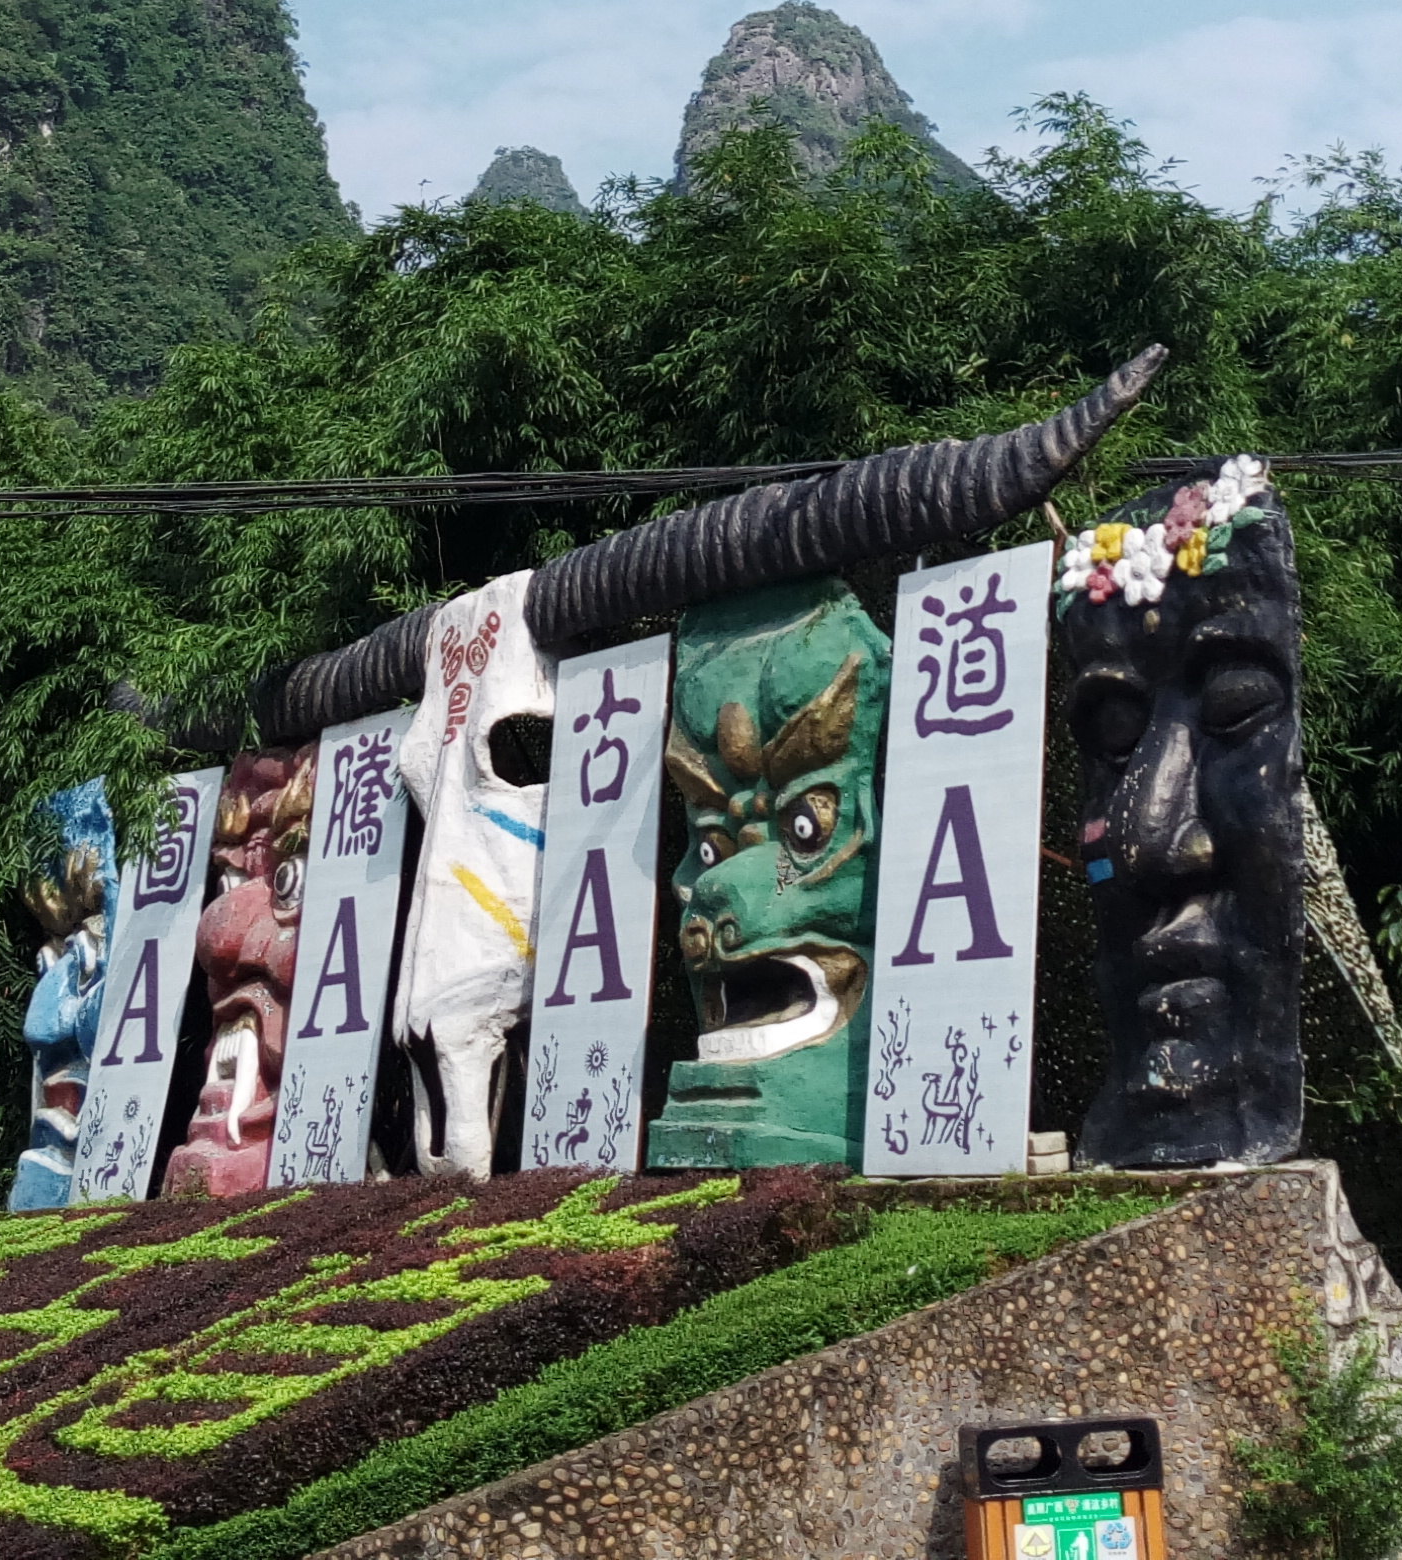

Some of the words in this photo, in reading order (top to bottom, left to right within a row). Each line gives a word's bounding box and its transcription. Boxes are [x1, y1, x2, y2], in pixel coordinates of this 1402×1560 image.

[915, 572, 1017, 739] 道
[573, 668, 642, 807] 古
[544, 847, 632, 1008] A
[891, 785, 1013, 966] A
[100, 938, 164, 1067] A
[297, 896, 370, 1039] A
